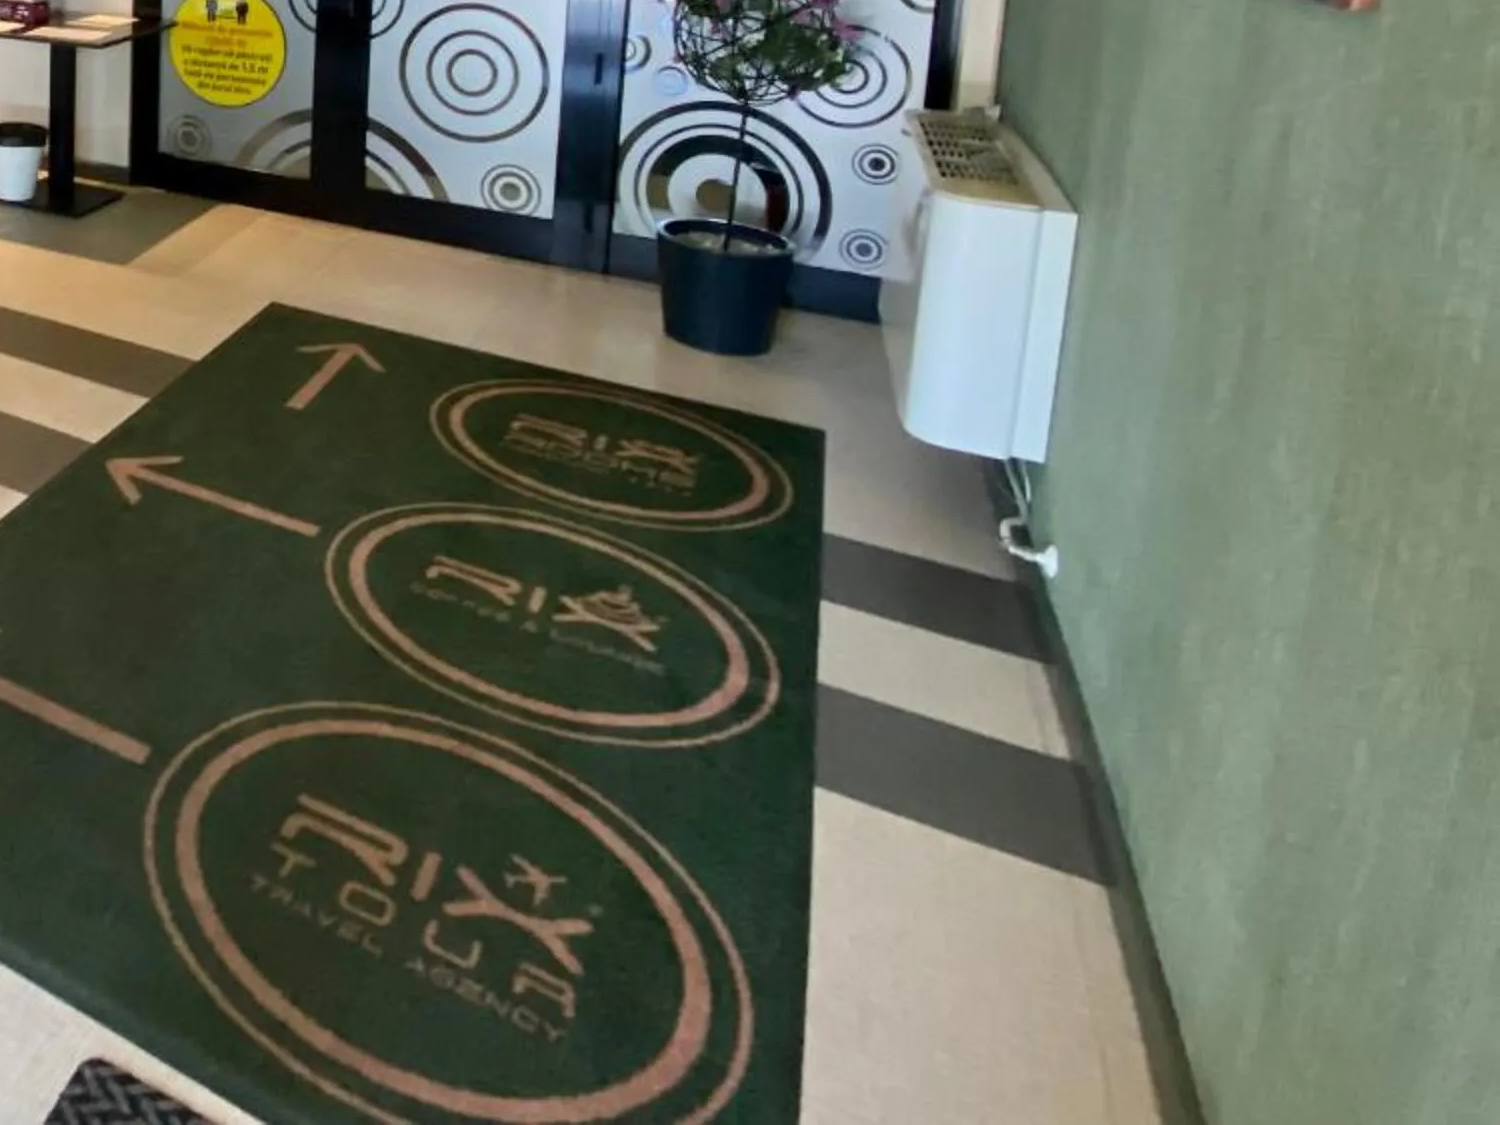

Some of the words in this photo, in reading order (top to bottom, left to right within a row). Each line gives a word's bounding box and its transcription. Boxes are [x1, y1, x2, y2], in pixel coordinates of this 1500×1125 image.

[424, 555, 662, 653] RIX
[250, 871, 384, 961] TRAVEL
[402, 954, 570, 1046] AGENCY
[271, 841, 577, 1019] TOUR
[279, 792, 595, 976] RIX
